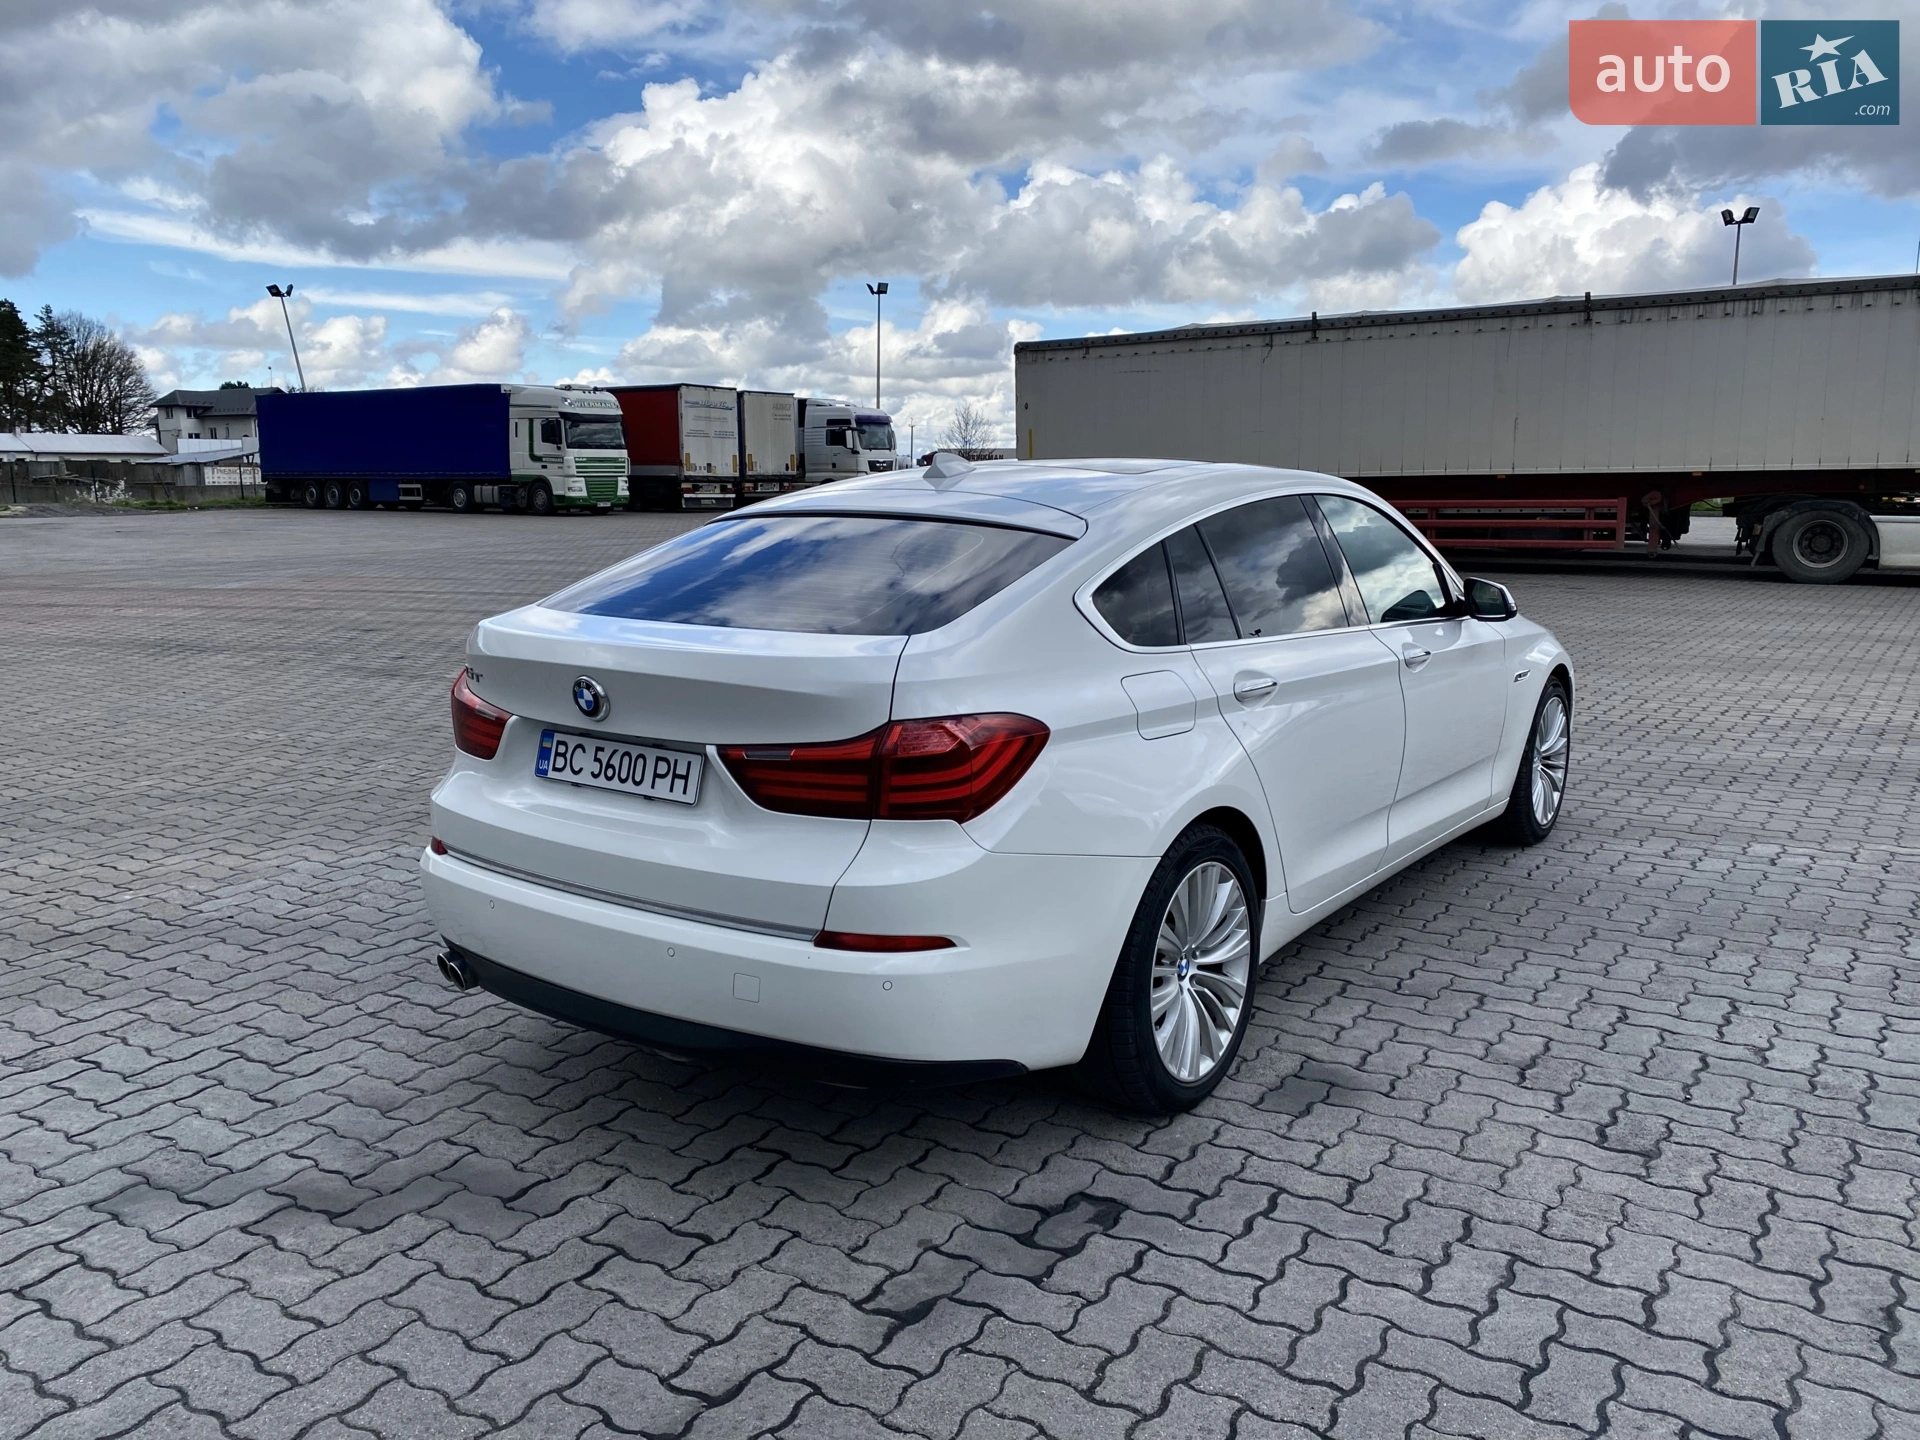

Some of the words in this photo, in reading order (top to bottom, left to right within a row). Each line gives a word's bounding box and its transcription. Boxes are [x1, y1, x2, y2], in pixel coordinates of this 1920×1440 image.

[538, 759, 549, 771] UA
[551, 739, 586, 776] BC
[590, 746, 647, 787] 5600
[650, 755, 692, 795] PH
